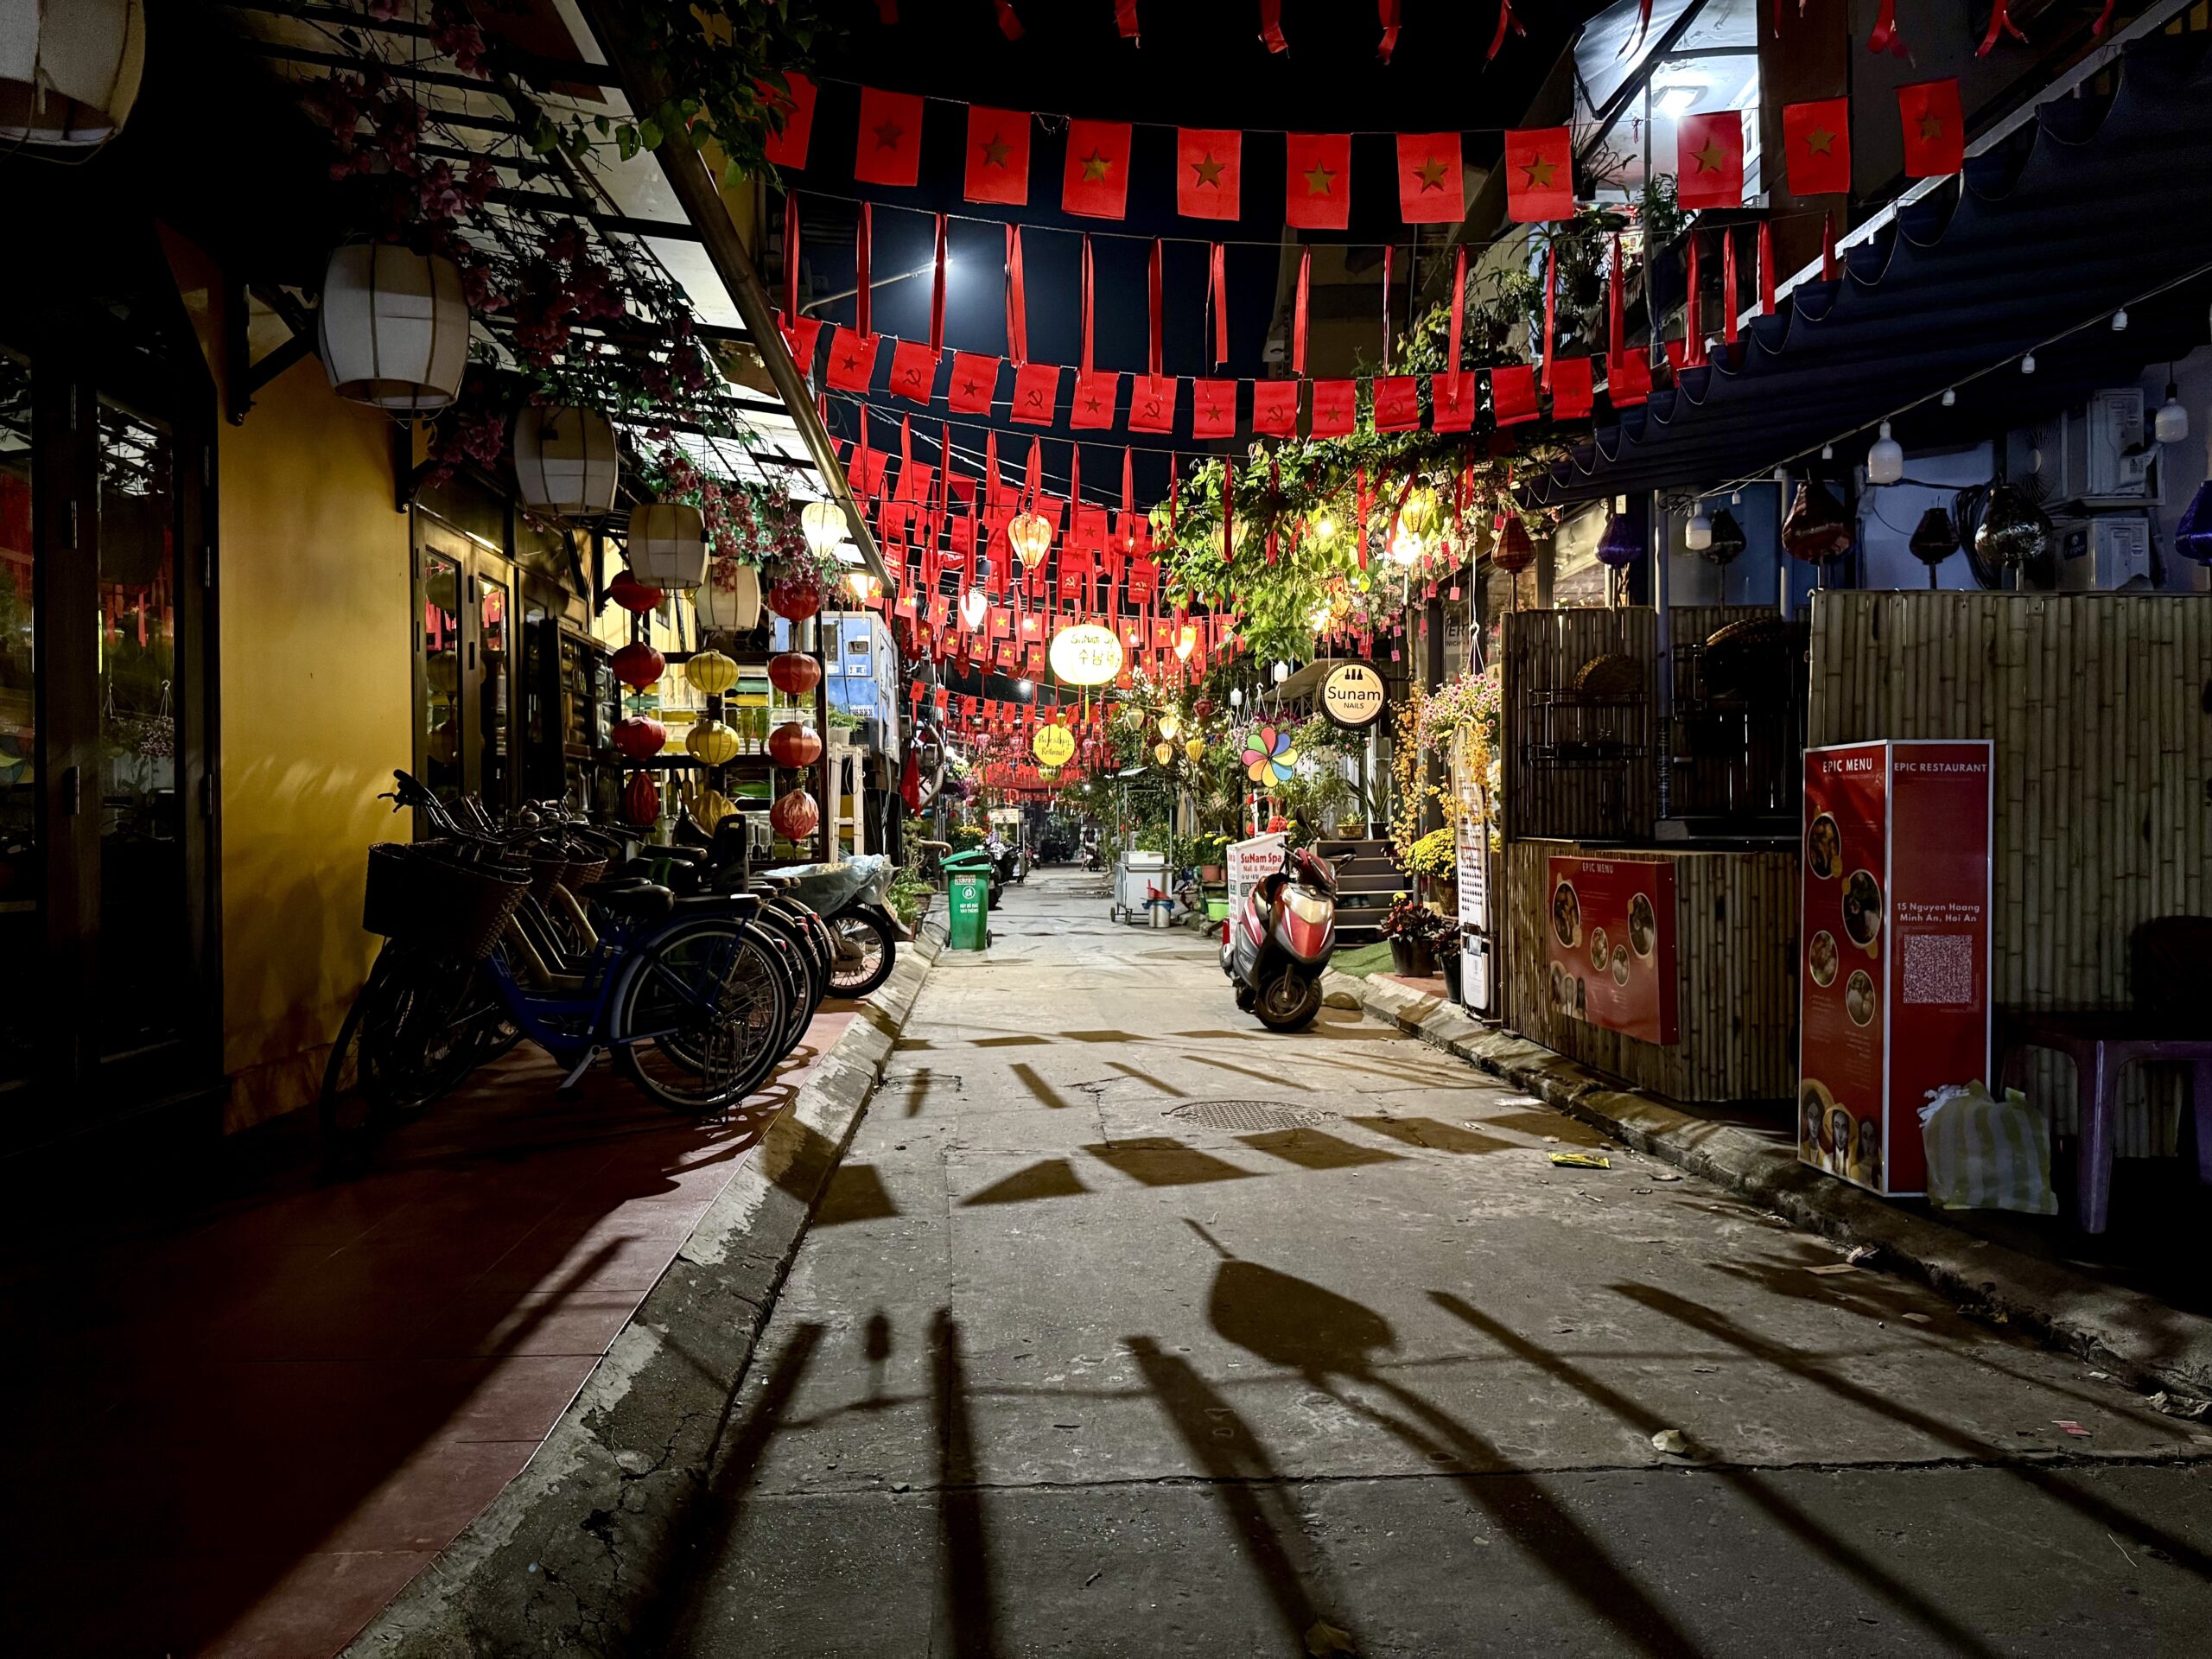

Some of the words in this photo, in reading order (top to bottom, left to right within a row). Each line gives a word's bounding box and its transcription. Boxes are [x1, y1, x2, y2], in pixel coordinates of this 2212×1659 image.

[1327, 686, 1381, 701] Sunam
[1823, 760, 1842, 773] EPIC
[1846, 758, 1872, 772] MENU
[1894, 763, 1916, 772] EPIC
[1919, 763, 1987, 772] RESTAURANT
[1241, 853, 1267, 863] SuNam
[1268, 853, 1281, 864] Spa
[1582, 862, 1596, 873] EPIC
[1597, 863, 1613, 874] MENU
[1910, 903, 1946, 912] Nguyen
[1949, 903, 1980, 913] Hoang
[1899, 913, 1923, 922] Minh
